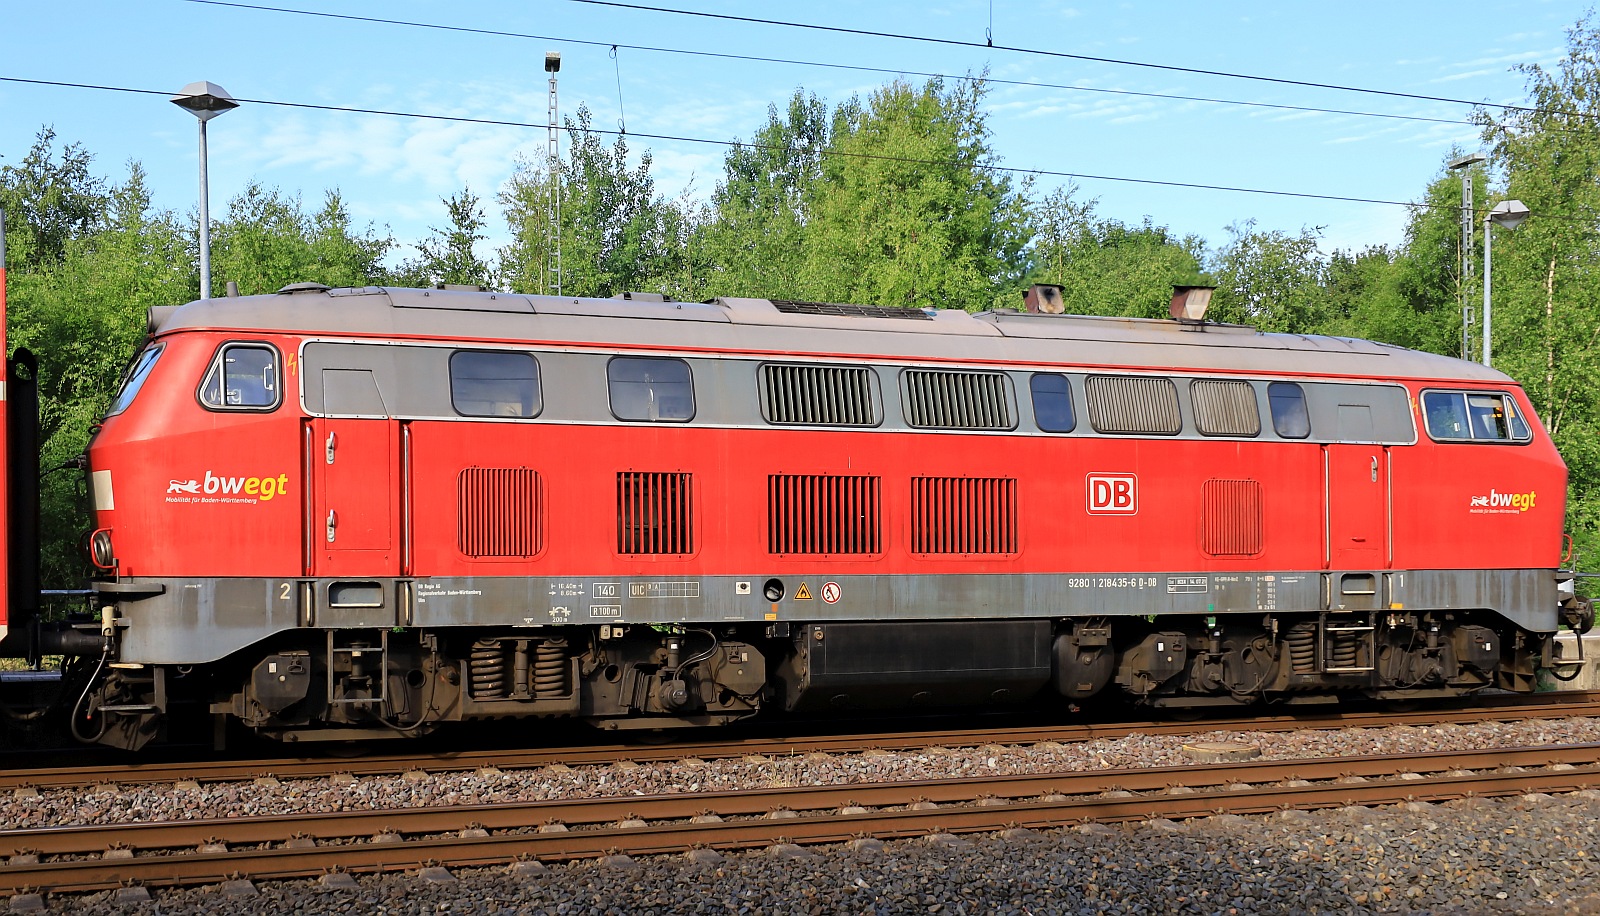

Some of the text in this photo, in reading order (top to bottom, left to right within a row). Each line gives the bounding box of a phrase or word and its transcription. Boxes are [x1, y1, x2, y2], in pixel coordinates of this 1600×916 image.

[203, 470, 289, 501] bwegt
[191, 496, 201, 504] für
[201, 496, 257, 504] Baden-Württemberg
[1093, 480, 1132, 507] DB
[1490, 488, 1537, 512] bwegt
[1068, 577, 1157, 590] 9280 1 218435-6 D-DB
[1399, 574, 1404, 588] 1
[280, 583, 291, 600] 2
[597, 585, 615, 596] 140
[631, 584, 645, 596] UIC
[593, 607, 598, 616] R
[598, 607, 611, 616] 100
